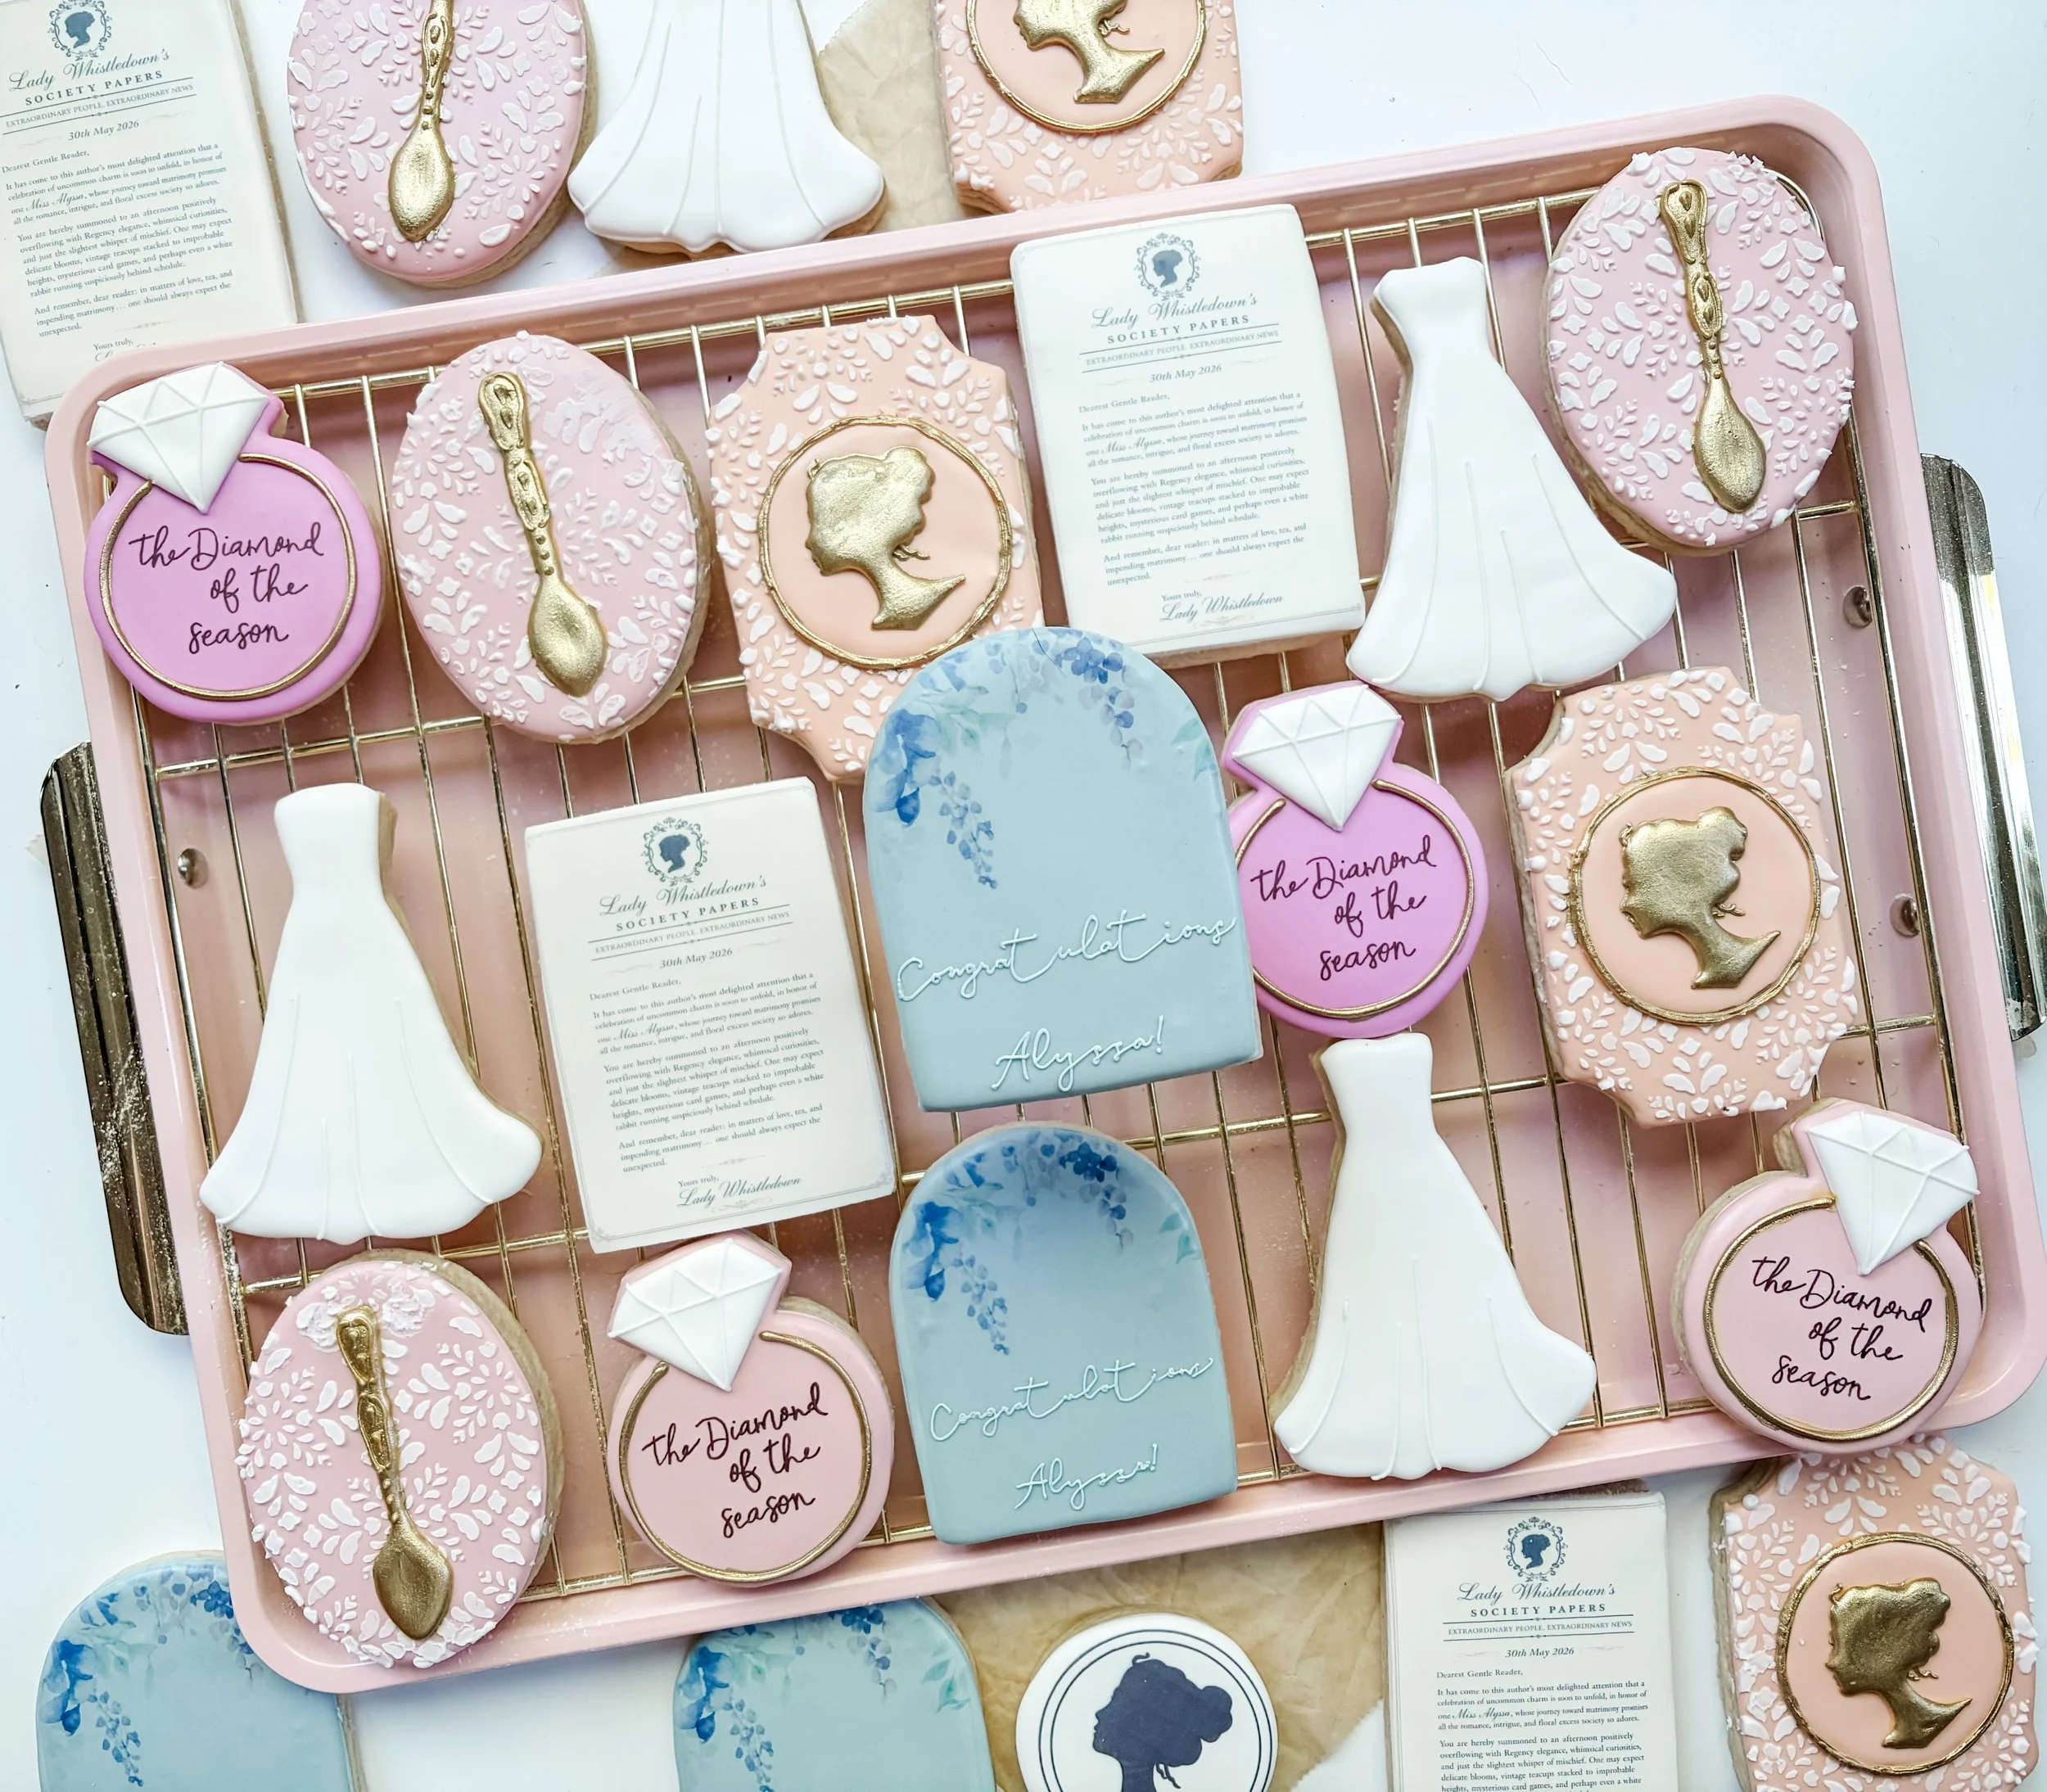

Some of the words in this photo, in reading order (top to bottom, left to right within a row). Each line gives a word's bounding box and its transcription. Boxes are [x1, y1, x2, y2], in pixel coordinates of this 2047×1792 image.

[9, 70, 54, 91] Lady
[63, 48, 169, 80] Whistledown's
[6, 108, 71, 128] EXTRAORDINARY
[106, 88, 169, 107] EXTRAORDINARY
[171, 84, 194, 93] NEWS
[25, 84, 96, 106] SOCIETY
[105, 70, 162, 89] PAPERS
[68, 129, 90, 141] 30th
[93, 127, 115, 136] May
[116, 120, 139, 132] 2026
[2, 162, 30, 174] Dearest
[33, 156, 59, 166] Gentle
[61, 151, 90, 160] Reader,
[17, 234, 33, 242] You
[48, 225, 74, 236] hereby
[76, 214, 117, 230] summoned
[142, 205, 179, 217] afternoon
[182, 196, 216, 211] positively
[1091, 307, 1139, 331] Lady
[1148, 293, 1257, 321] Whistledown's
[1108, 325, 1180, 345] SOCIETY
[1190, 315, 1249, 332] PAPERS
[93, 343, 114, 351] Yours
[115, 338, 134, 346] truly,
[1086, 349, 1155, 366] EXTRAORDINARY
[1190, 333, 1255, 350] EXTRAORDINARY
[1257, 330, 1279, 340] NEWS
[1150, 371, 1172, 383] 30th
[1175, 369, 1196, 380] May
[1199, 364, 1222, 375] 2026
[1078, 403, 1109, 413] Dearest
[1110, 397, 1138, 408] Gentle
[1140, 393, 1170, 404] Reader,
[1096, 512, 1125, 521] delicate
[1127, 507, 1157, 516] blooms,
[1159, 502, 1186, 511] vintage
[1188, 497, 1216, 506] teacups
[1218, 490, 1246, 501] stacked
[1259, 481, 1301, 495] improbable
[129, 525, 191, 568] the
[188, 521, 324, 571] Diamond
[210, 567, 240, 614] of
[250, 563, 309, 603] the
[1161, 594, 1182, 603] Yours
[1183, 589, 1203, 598] truly,
[1159, 603, 1199, 623] Lady
[1202, 592, 1283, 613] Whistledown
[188, 622, 289, 654] season
[1250, 860, 1308, 901] the
[1306, 834, 1437, 899] Diamond
[599, 895, 647, 916] Lady
[657, 875, 766, 906] Whistledown's
[1335, 892, 1363, 937] of
[1371, 880, 1427, 919] the
[595, 936, 663, 954] EXTRAORDINARY
[700, 916, 766, 934] EXTRAORDINARY
[767, 911, 790, 921] NEWS
[616, 910, 689, 932] SOCIETY
[699, 897, 759, 916] PAPERS
[660, 957, 682, 969] 30th
[685, 955, 707, 964] May
[709, 948, 733, 959] 2026
[897, 909, 1236, 1002] Congratulations
[1319, 941, 1417, 981] season
[590, 991, 620, 1001] Dearest
[622, 984, 649, 995] Gentle
[652, 979, 681, 990] Reader,
[990, 1014, 1164, 1091] Alyssa!
[616, 1122, 637, 1131] rabbit
[639, 1116, 671, 1126] running
[671, 1106, 714, 1121] suspiciously
[716, 1100, 741, 1112] behind
[743, 1095, 776, 1107] schedule.
[677, 1189, 716, 1209] Lady
[720, 1175, 801, 1198] Whistledown
[678, 1180, 699, 1188] Yours
[700, 1175, 720, 1184] truly,
[1751, 1256, 1807, 1293] the
[1800, 1269, 1932, 1333] Diamond
[1808, 1316, 1842, 1360] of
[1850, 1323, 1904, 1360] the
[1772, 1355, 1871, 1401] season
[929, 1357, 1213, 1442] Congratulations
[641, 1423, 701, 1466] the
[695, 1381, 829, 1460] Diamond
[730, 1448, 761, 1492] of
[762, 1433, 821, 1474] the
[1014, 1443, 1158, 1511] Alyssa!
[721, 1492, 816, 1538] season
[1457, 1582, 1502, 1606] Lady
[1512, 1582, 1615, 1600] Whistledown's
[1471, 1606, 1540, 1618] SOCIETY
[1549, 1604, 1606, 1614] PAPERS
[1448, 1626, 1513, 1636] EXTRAORDINARY
[1548, 1623, 1610, 1631] EXTRAORDINARY
[1505, 1649, 1527, 1658] 30th
[1530, 1648, 1550, 1659] May
[1552, 1647, 1575, 1656] 2026
[1495, 1668, 1523, 1677] Reader,
[1557, 1682, 1589, 1692] delighted
[1625, 1680, 1639, 1688] that
[1439, 1751, 1484, 1760] overflowing
[1485, 1749, 1502, 1758] with
[1504, 1749, 1534, 1758] Regency
[1536, 1747, 1568, 1757] elegance,
[1570, 1745, 1604, 1754] whimsical
[1606, 1744, 1643, 1752] curiosities,
[1471, 1739, 1495, 1748] hereby
[1498, 1736, 1538, 1745] summoned
[1562, 1735, 1598, 1743] afternoon
[1601, 1732, 1634, 1743] positively
